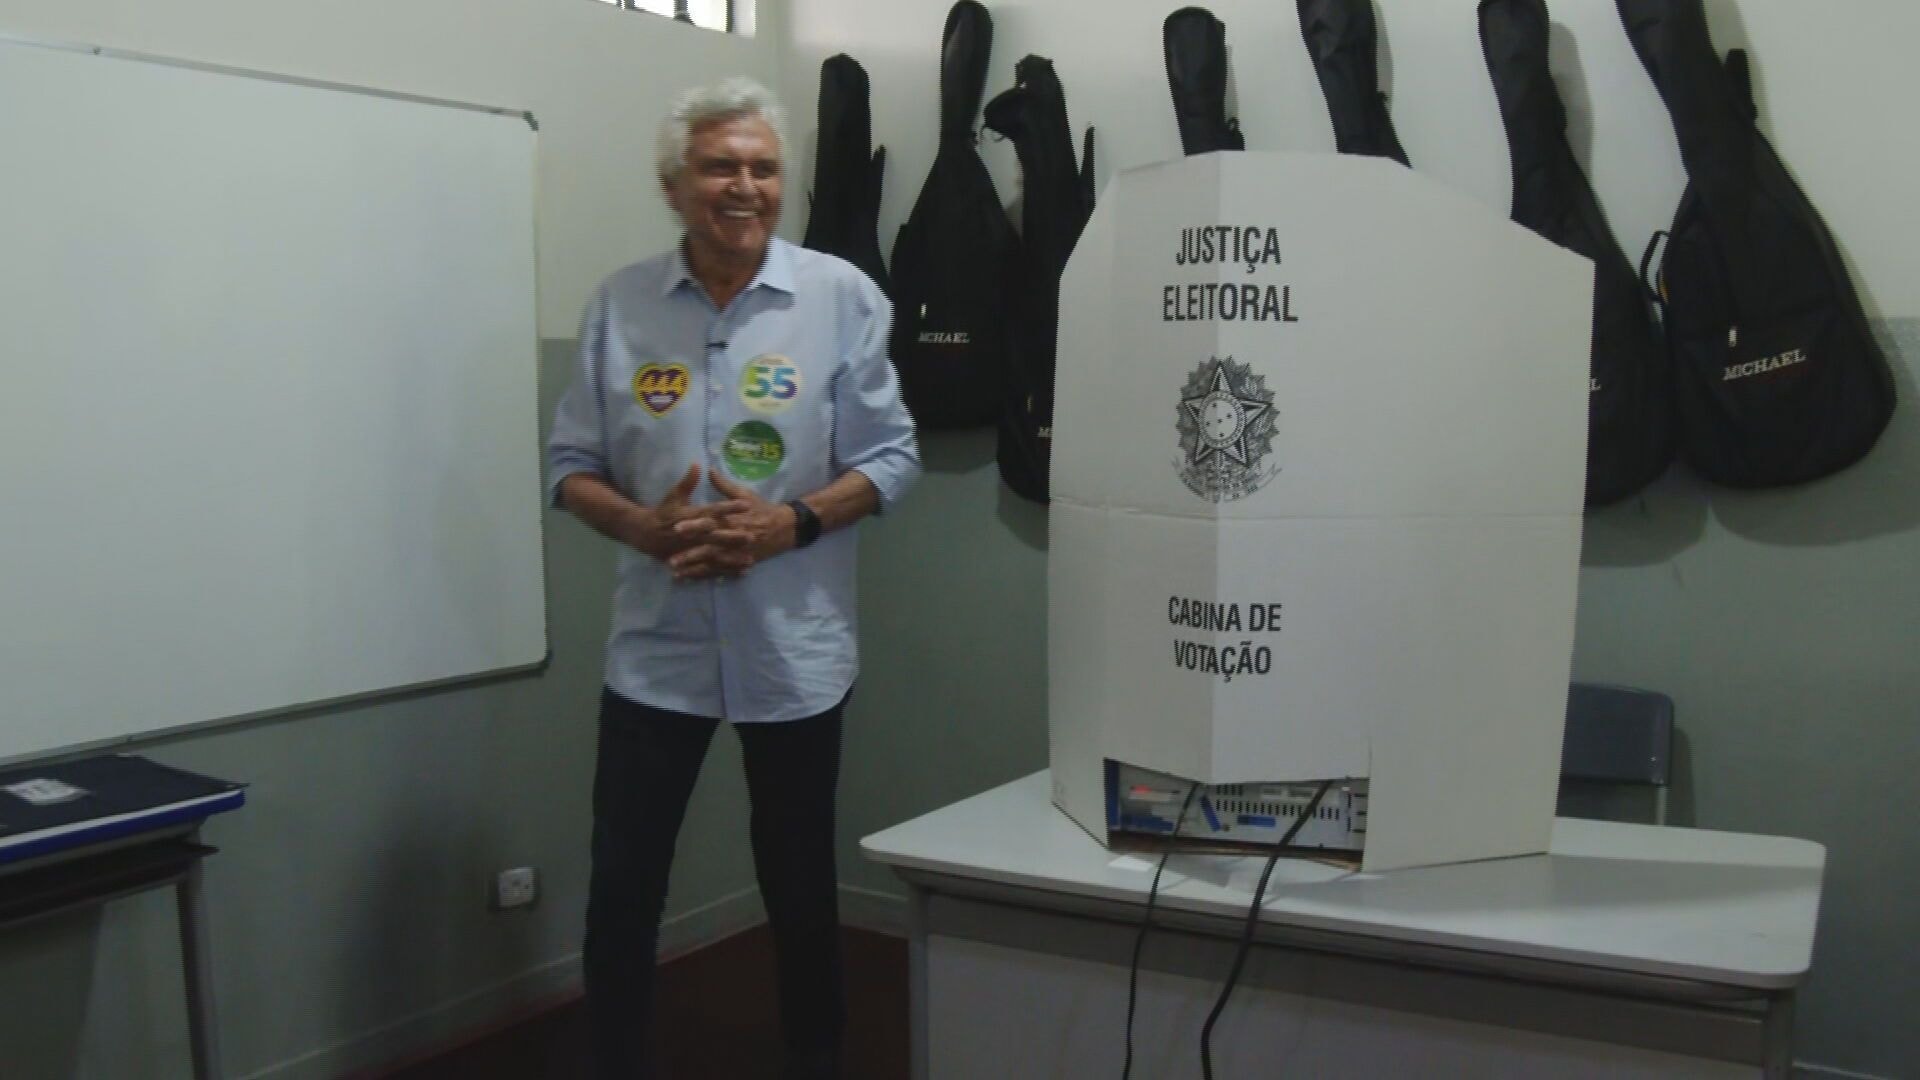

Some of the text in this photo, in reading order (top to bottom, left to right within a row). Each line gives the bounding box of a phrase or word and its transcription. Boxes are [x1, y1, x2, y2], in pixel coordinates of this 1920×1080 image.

[1176, 226, 1281, 273] JUSTIÇA
[1163, 283, 1298, 321] ELEITORAL
[1722, 349, 1806, 380] MICHAEL
[639, 372, 686, 394] 444
[744, 366, 798, 399] 55
[1168, 596, 1282, 631] CABINA DE
[1174, 640, 1271, 683] VOTAÇÃO
